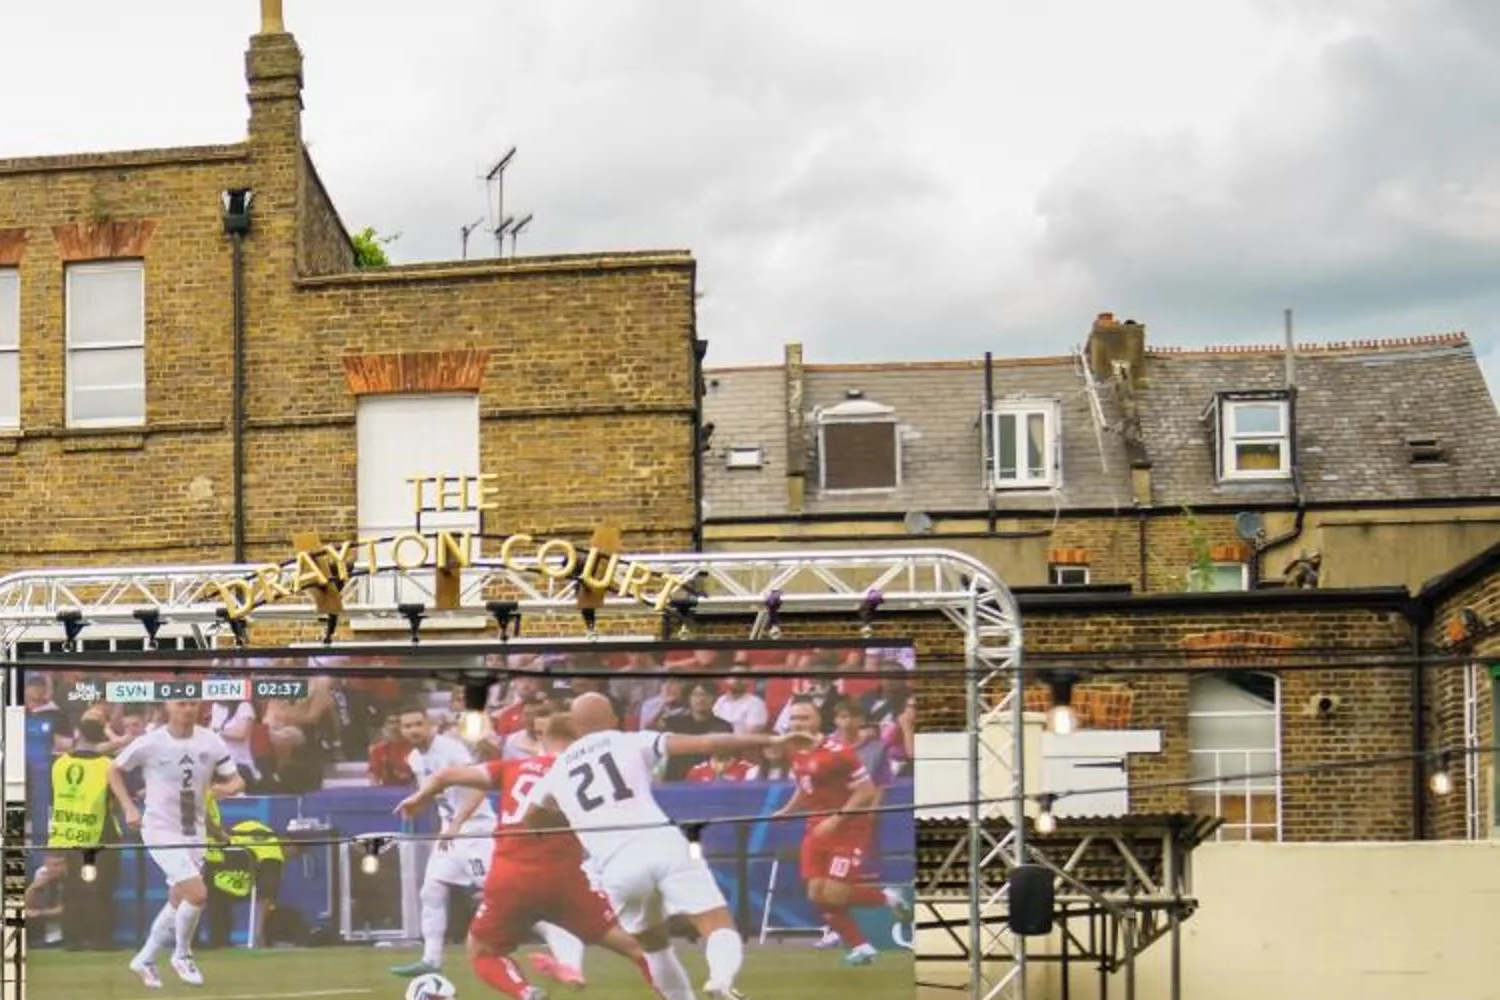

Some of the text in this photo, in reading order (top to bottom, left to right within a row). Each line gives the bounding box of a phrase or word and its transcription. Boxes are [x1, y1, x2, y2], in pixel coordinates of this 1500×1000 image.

[406, 473, 500, 512] THE
[218, 529, 684, 619] DRAYTON COURT
[115, 684, 148, 697] SVN
[160, 685, 171, 697] 0
[185, 685, 196, 697] 0
[207, 684, 241, 696] DEN
[257, 682, 301, 696] 02:37
[182, 769, 194, 788] 2
[568, 752, 634, 812] 21
